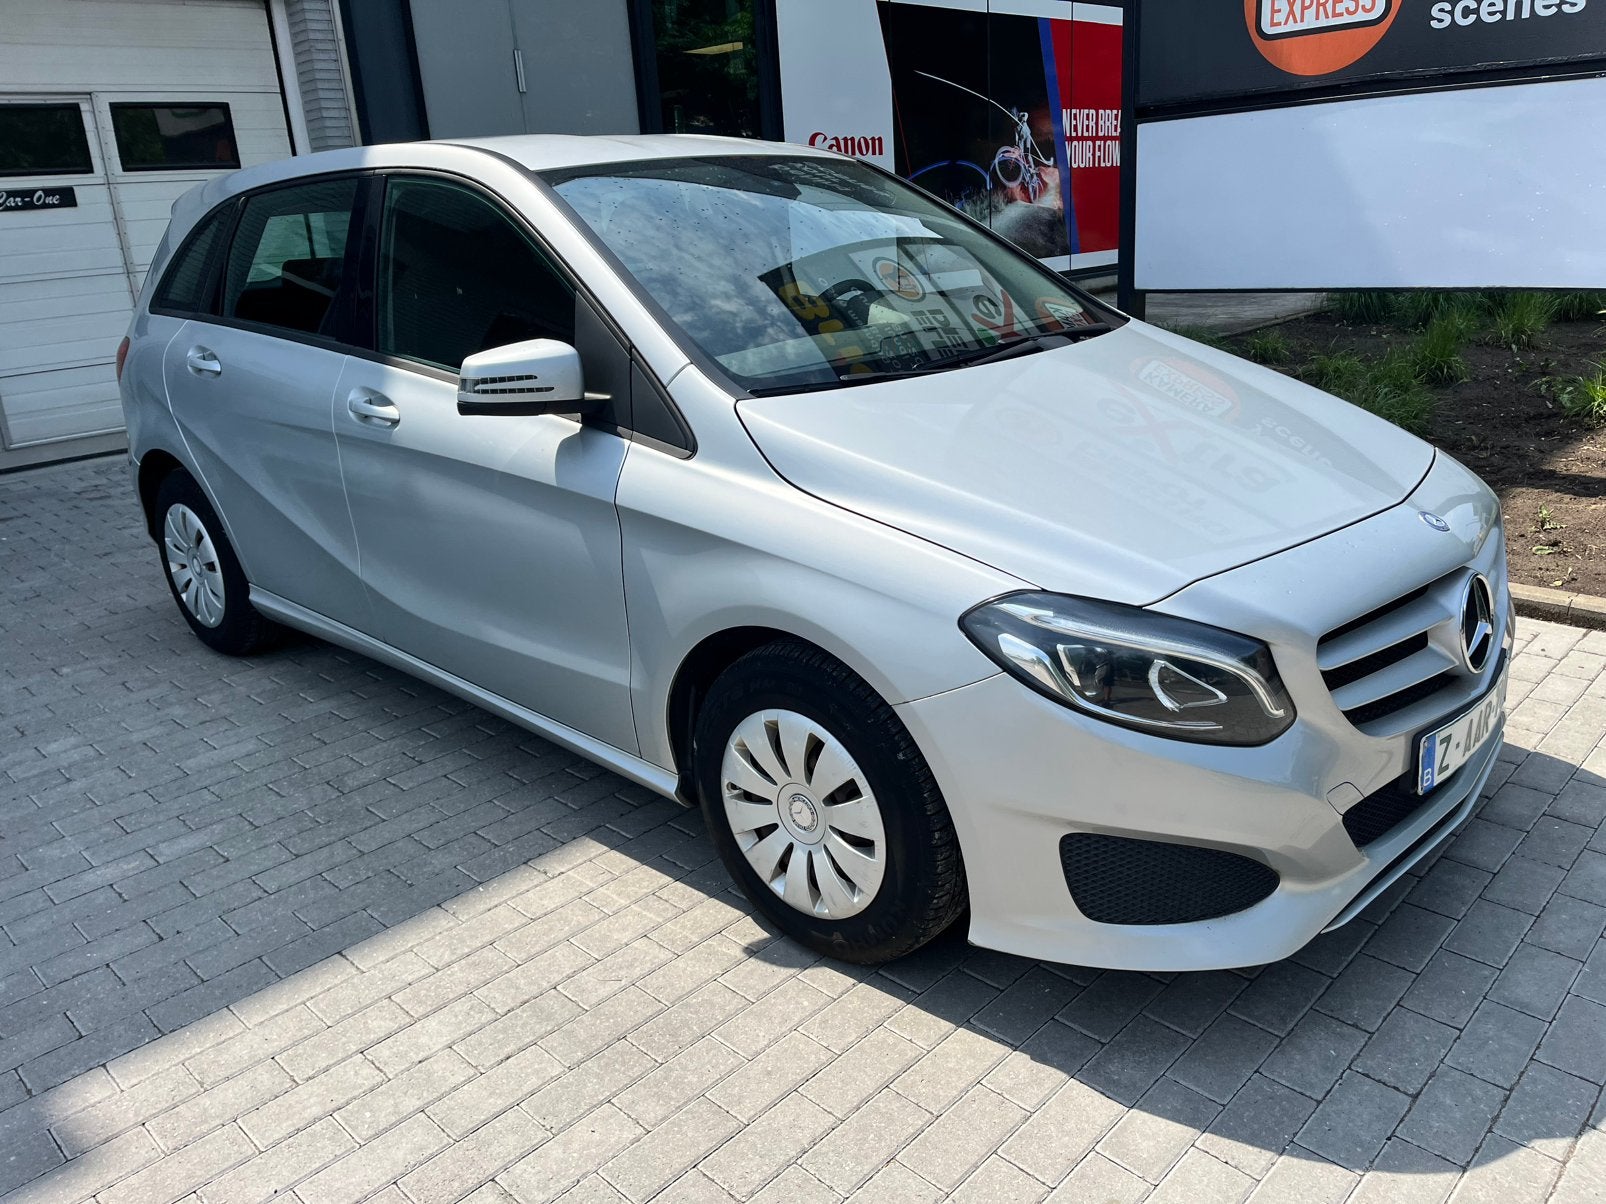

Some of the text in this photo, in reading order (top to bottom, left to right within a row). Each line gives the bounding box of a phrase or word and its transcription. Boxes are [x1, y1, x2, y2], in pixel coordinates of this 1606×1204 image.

[1062, 108, 1097, 137] NEVER
[808, 131, 884, 156] Canon
[1064, 140, 1121, 168] YOUR FLOW
[1436, 692, 1501, 777] Z-AAR-
[1423, 768, 1432, 787] B
